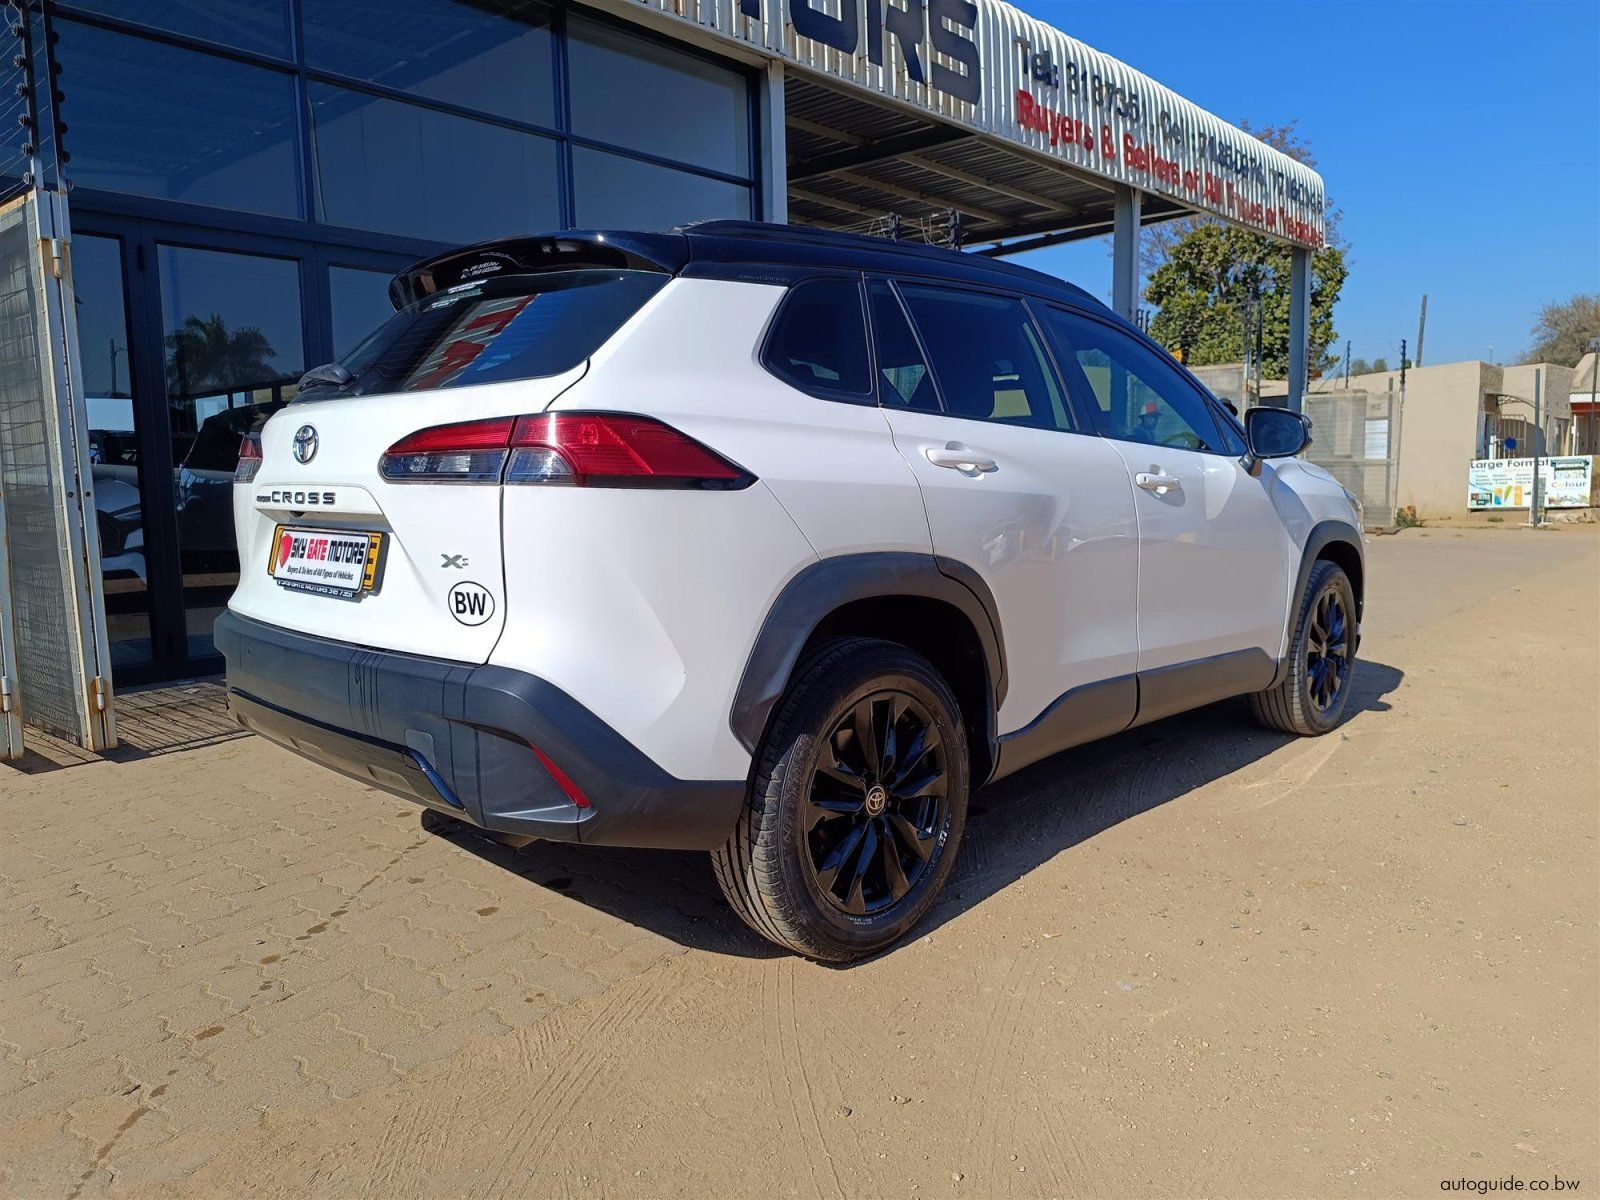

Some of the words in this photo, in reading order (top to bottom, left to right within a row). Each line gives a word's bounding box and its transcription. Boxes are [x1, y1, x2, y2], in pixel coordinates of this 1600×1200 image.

[1014, 35, 1059, 89] Tel:
[1017, 89, 1094, 153] Buyers
[1101, 125, 1115, 160] &
[1470, 460, 1503, 469] Large
[271, 491, 336, 505] CROSS
[290, 538, 308, 559] SKY
[306, 538, 328, 561] GATE
[327, 540, 367, 565] MOTORS
[454, 591, 486, 616] BW
